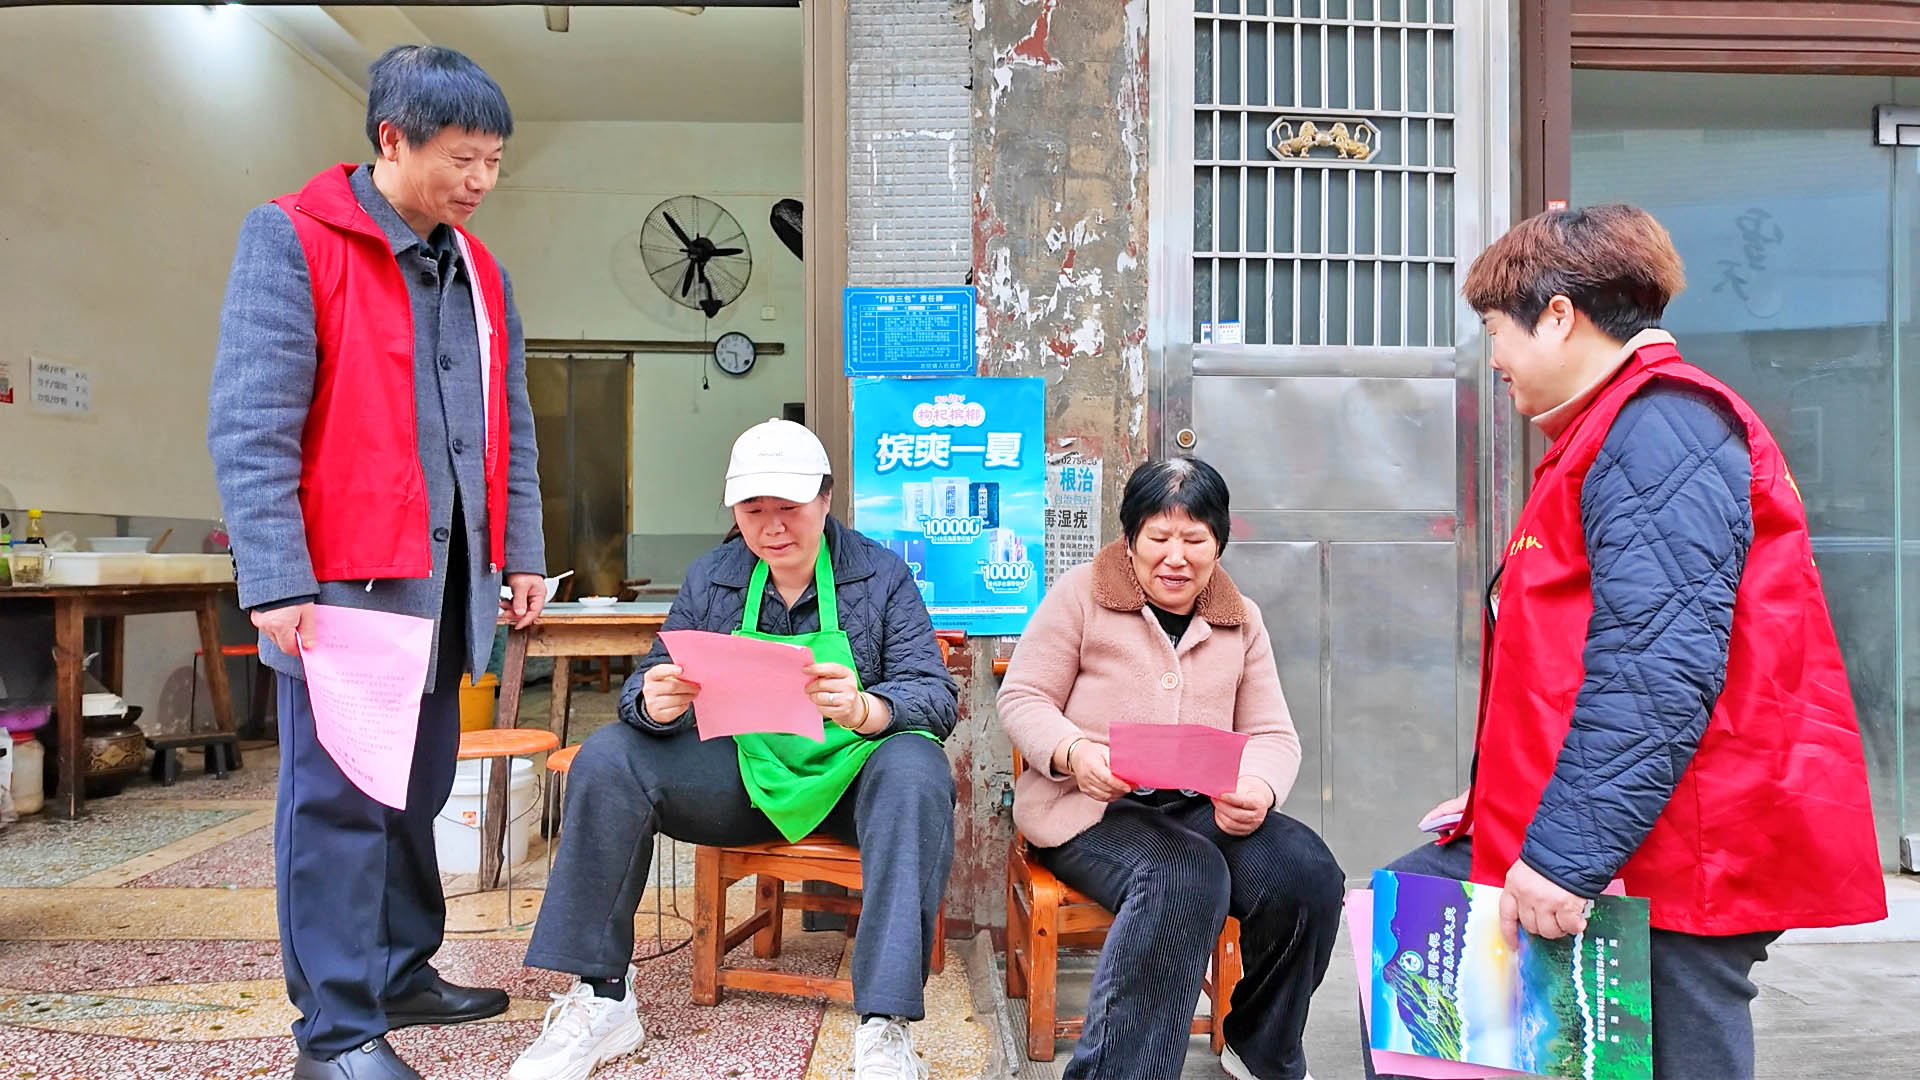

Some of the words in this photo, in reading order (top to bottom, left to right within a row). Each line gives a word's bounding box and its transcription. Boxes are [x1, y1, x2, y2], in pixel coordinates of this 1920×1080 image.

[917, 408, 981, 421] 枸杞槟榔
[876, 432, 1023, 471] 槟爽一夏
[1060, 467, 1094, 492] 根治
